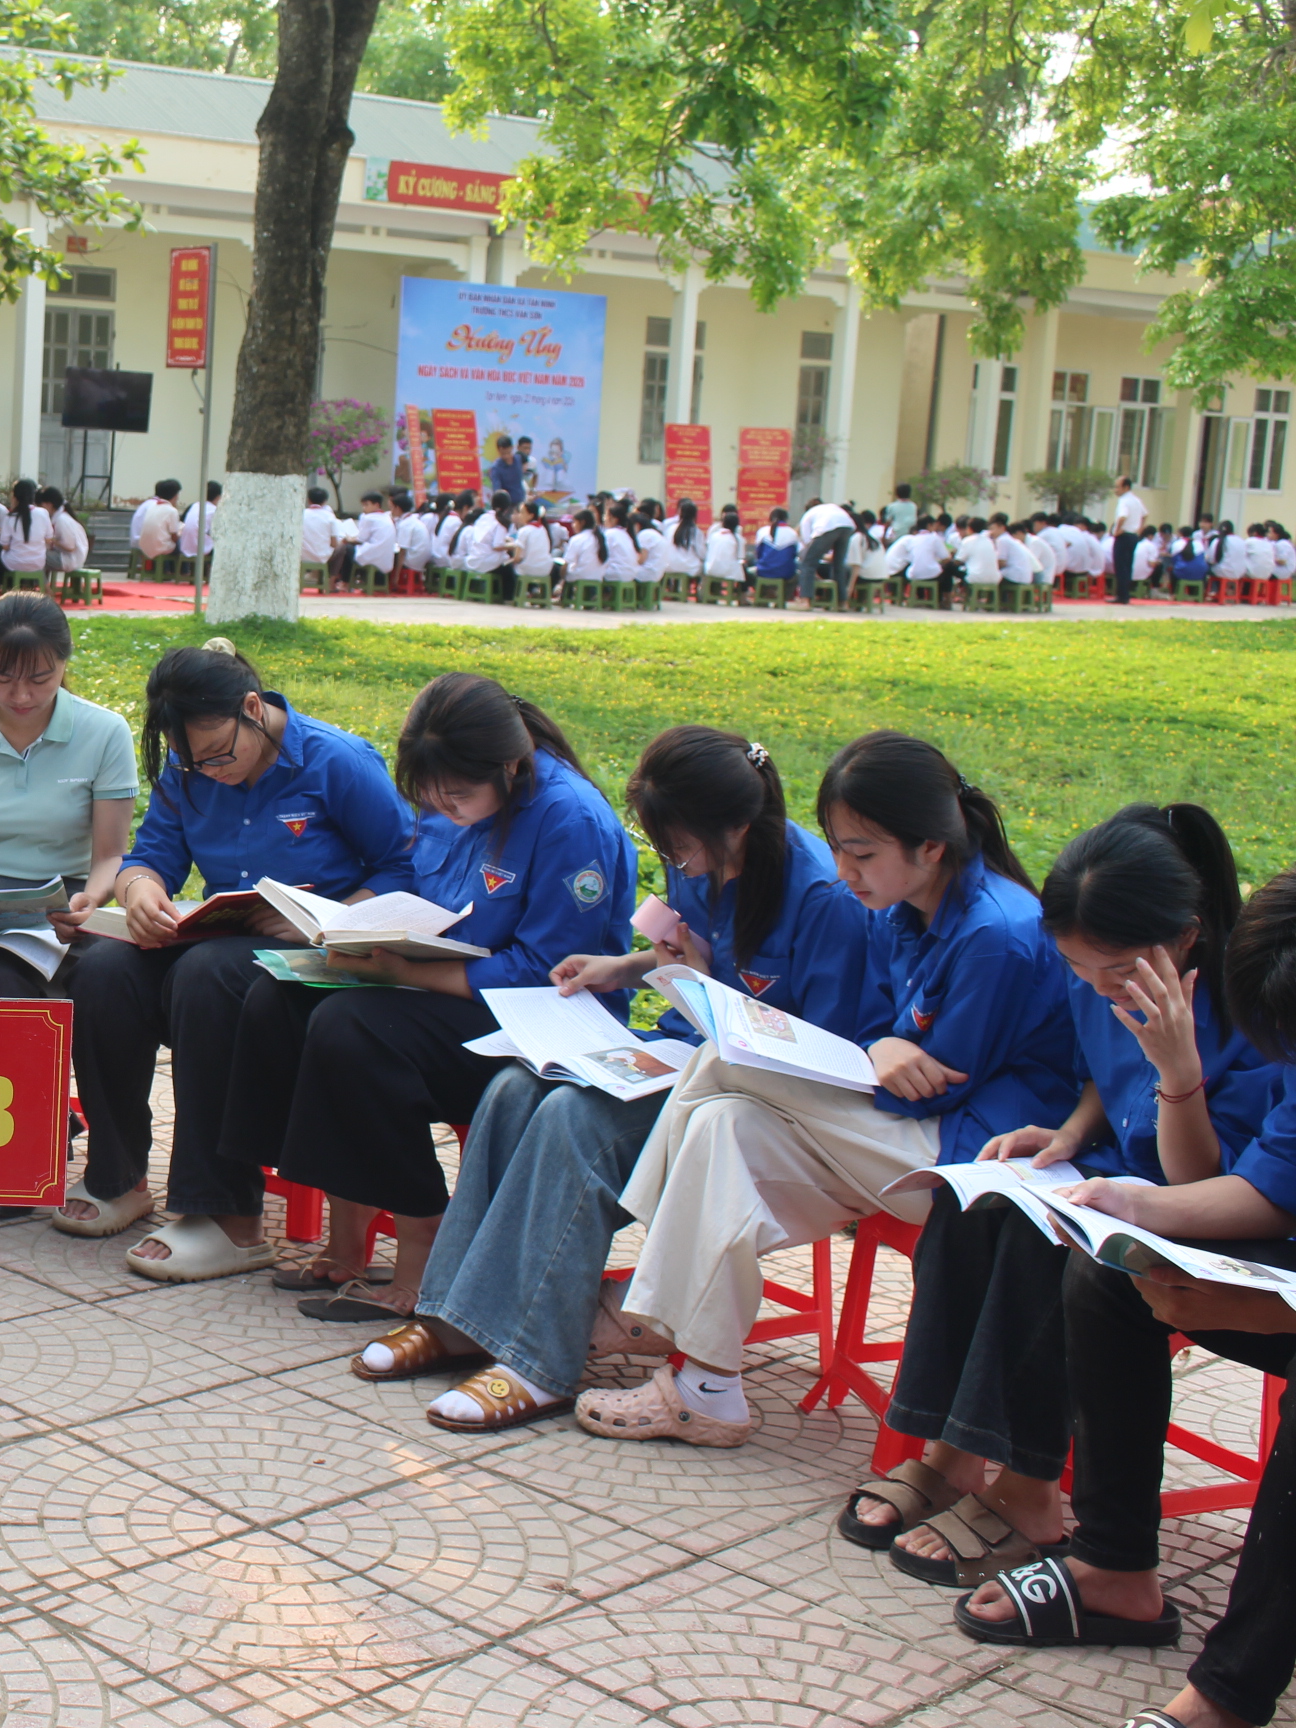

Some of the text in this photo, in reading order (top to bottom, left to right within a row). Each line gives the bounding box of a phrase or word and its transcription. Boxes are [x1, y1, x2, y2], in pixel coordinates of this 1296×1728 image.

[417, 175, 458, 200] CƯƠNG
[464, 179, 497, 204] SÁNG
[1004, 1561, 1057, 1604] &G
